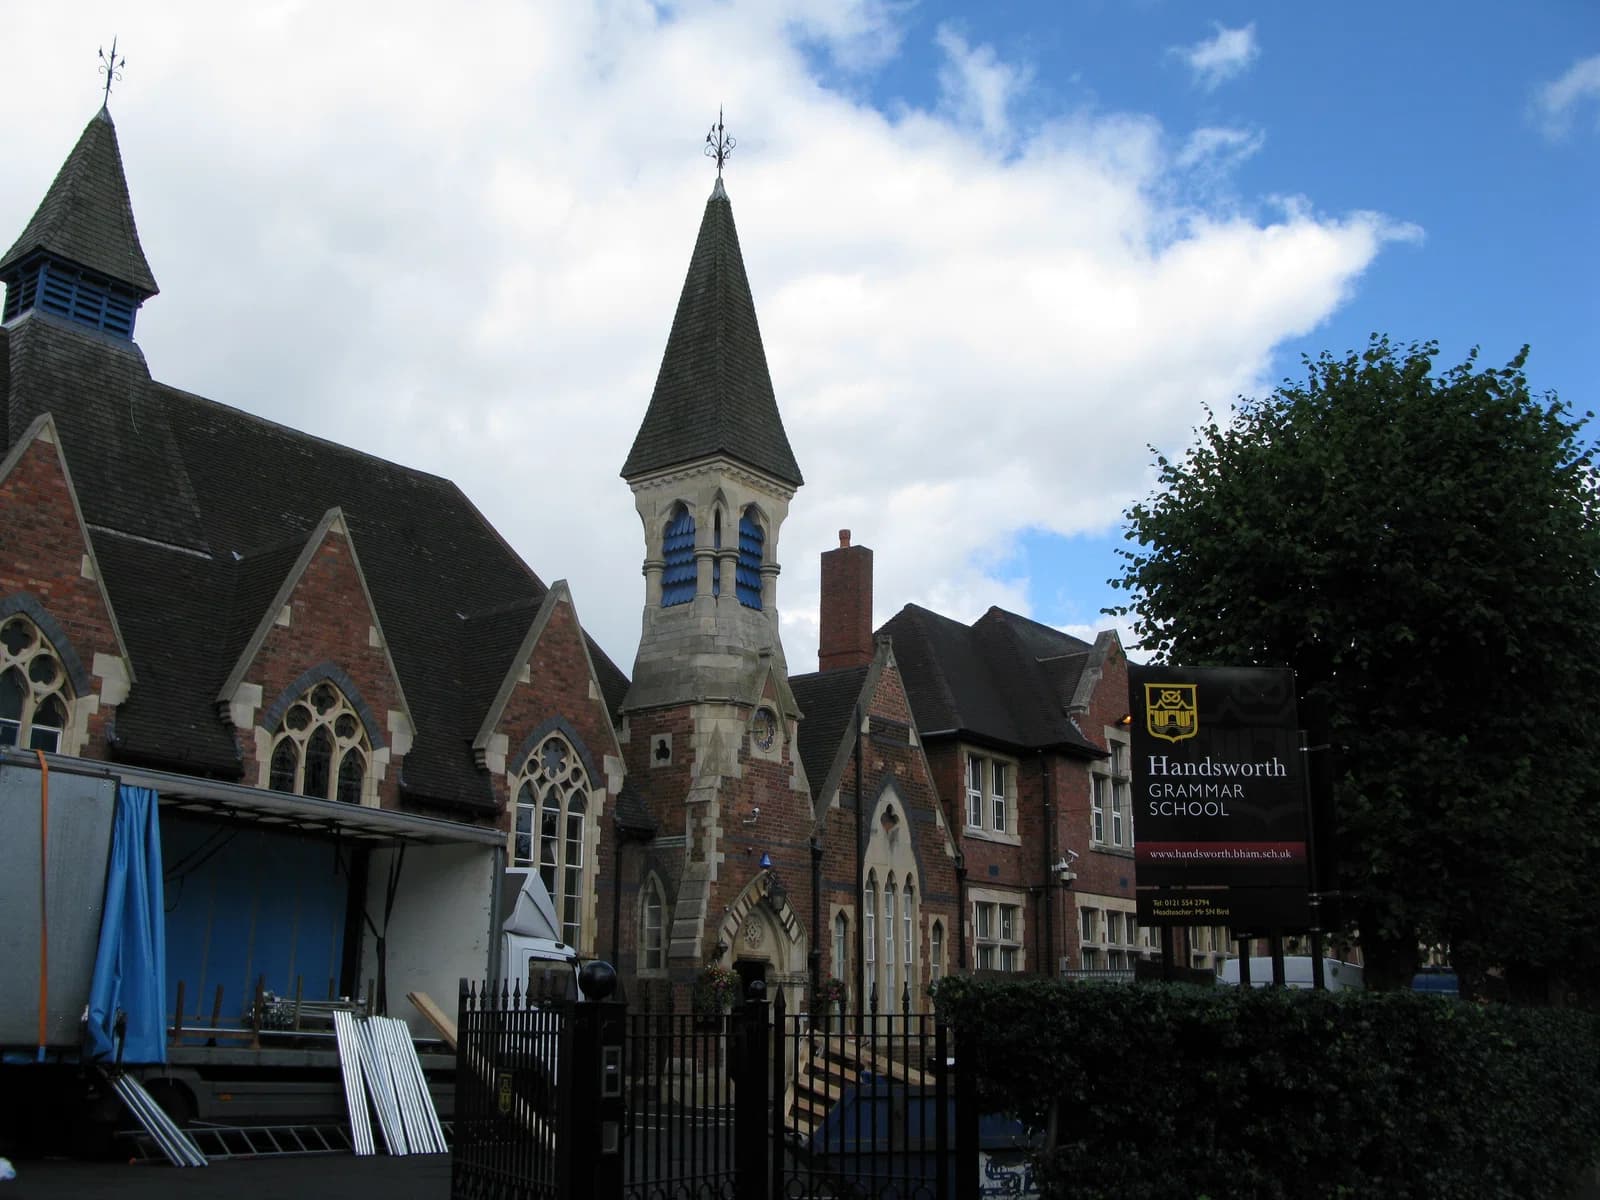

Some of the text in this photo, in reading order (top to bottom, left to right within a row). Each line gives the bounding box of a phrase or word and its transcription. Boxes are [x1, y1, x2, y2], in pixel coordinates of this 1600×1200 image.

[1147, 755, 1287, 777] Handsworth
[1149, 783, 1245, 798] GRAMMAR
[1149, 801, 1230, 816] SCHOOL
[1150, 848, 1292, 859] www.handsworth.bham.sch.uk
[1164, 899, 1179, 907] 0121
[1195, 908, 1204, 916] Mr
[1216, 908, 1230, 916] Bird
